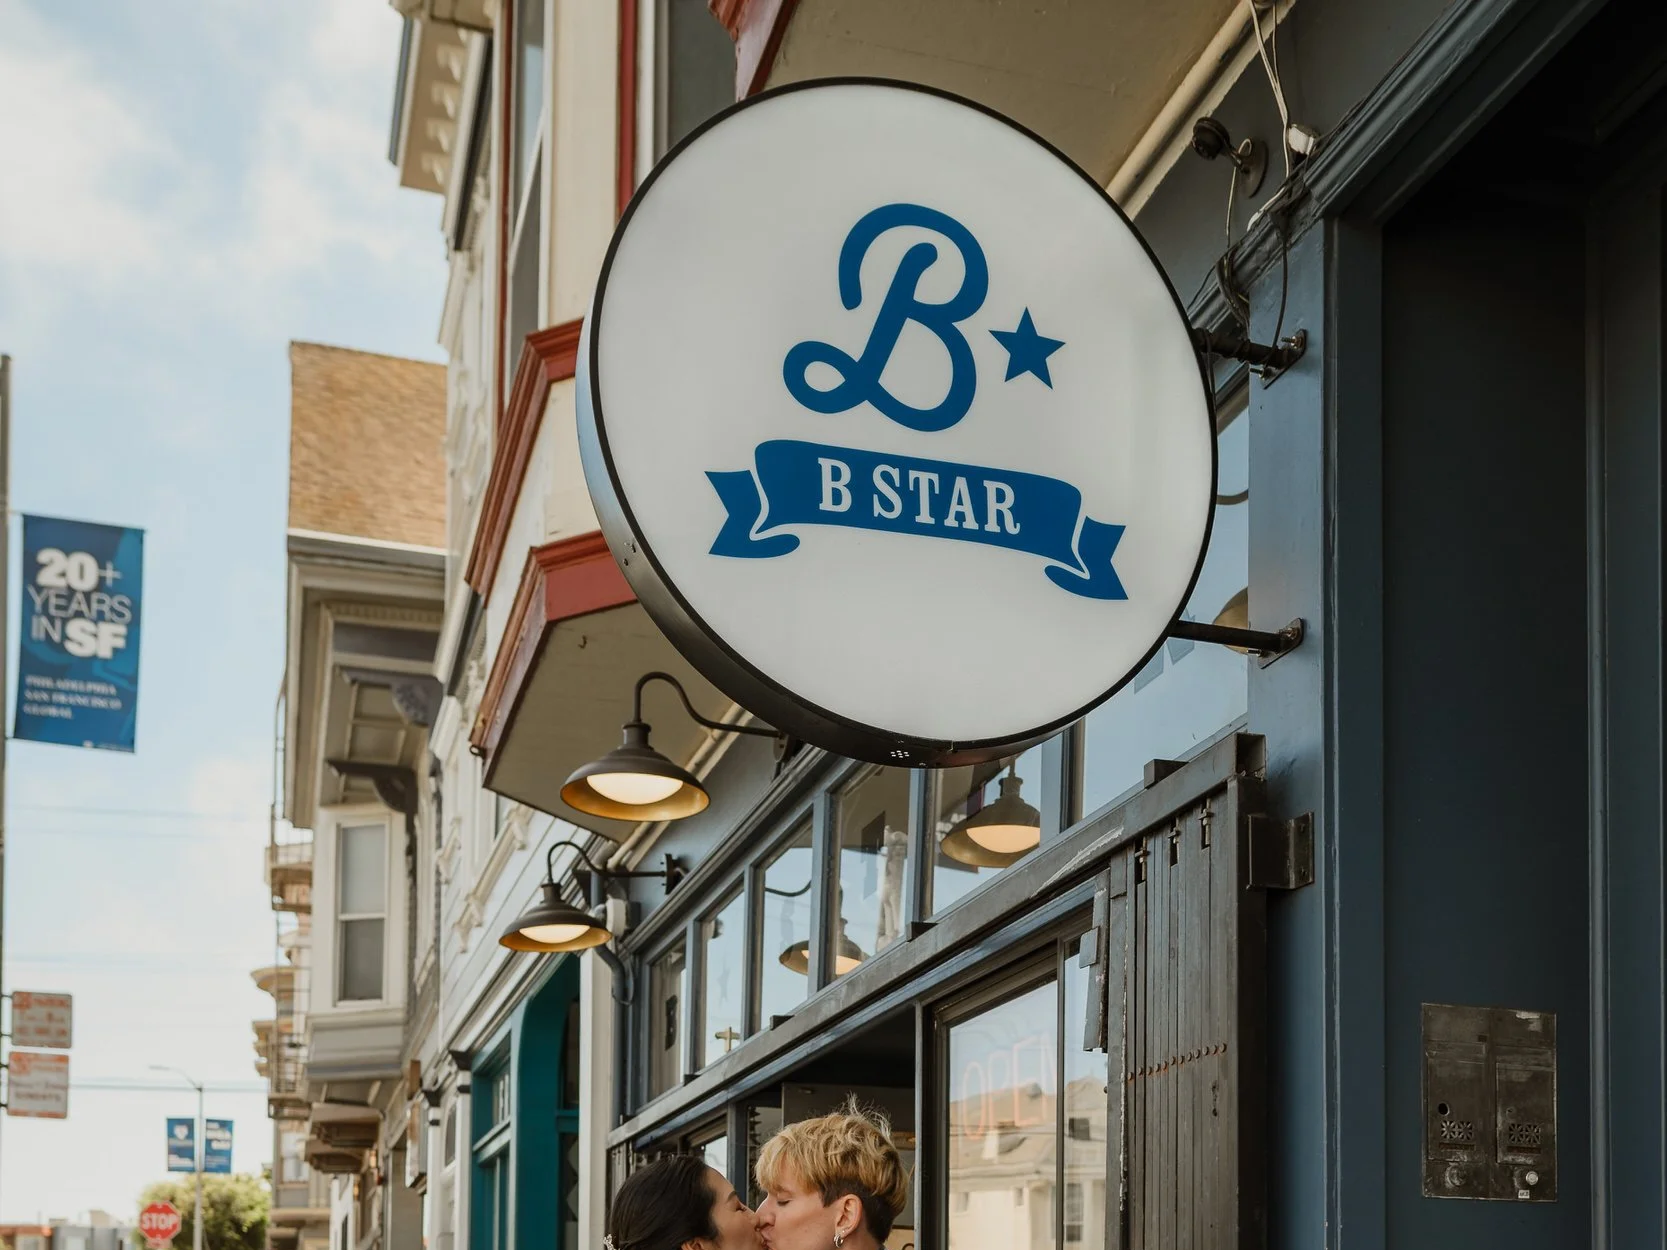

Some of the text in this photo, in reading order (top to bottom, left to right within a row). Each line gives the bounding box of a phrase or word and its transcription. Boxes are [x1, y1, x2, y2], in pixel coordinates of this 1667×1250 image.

[782, 203, 989, 432] B
[817, 457, 1021, 535] B STAR
[36, 547, 123, 592] 20+
[27, 584, 132, 625] YEARS
[31, 614, 127, 659] IN SF
[141, 1212, 178, 1230] STOP
